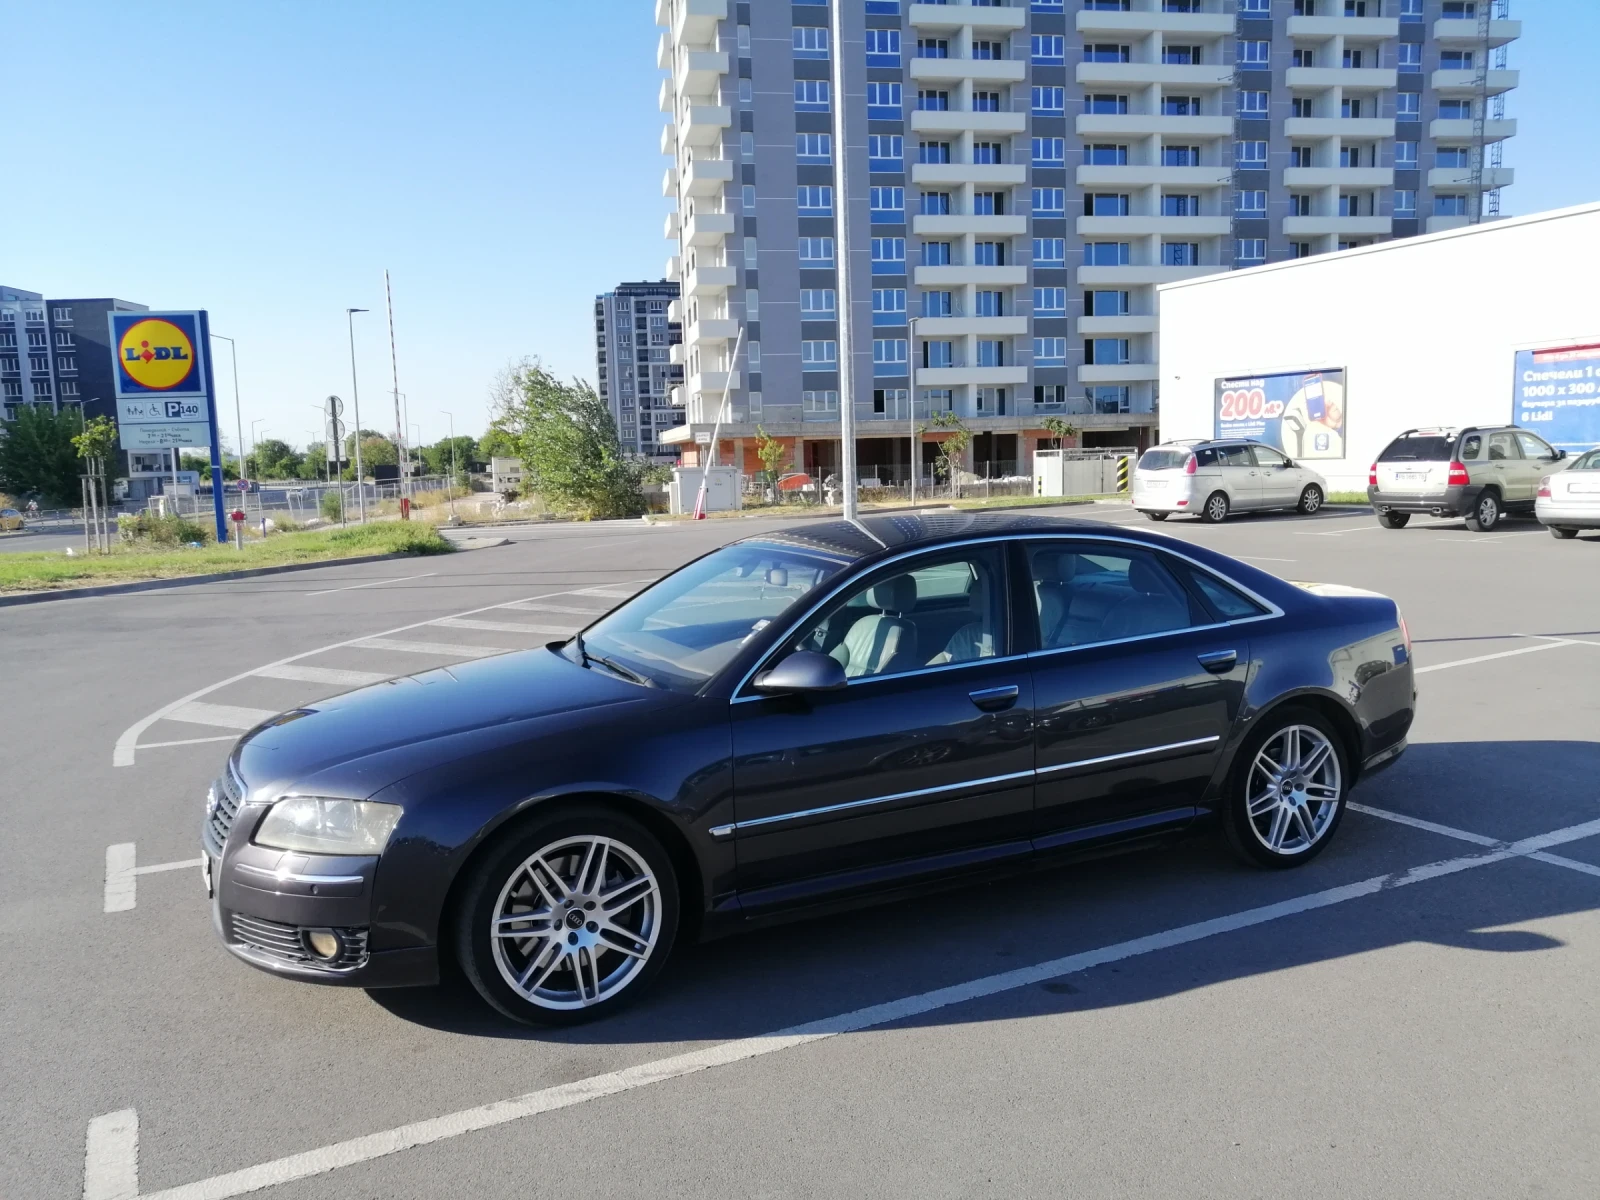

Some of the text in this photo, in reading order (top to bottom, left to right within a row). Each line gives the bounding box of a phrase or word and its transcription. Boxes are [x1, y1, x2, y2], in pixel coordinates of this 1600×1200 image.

[1585, 366, 1593, 377] 1
[1522, 384, 1555, 397] 1000
[1568, 382, 1595, 395] 300
[180, 405, 198, 413] 140
[1221, 389, 1264, 418] 200
